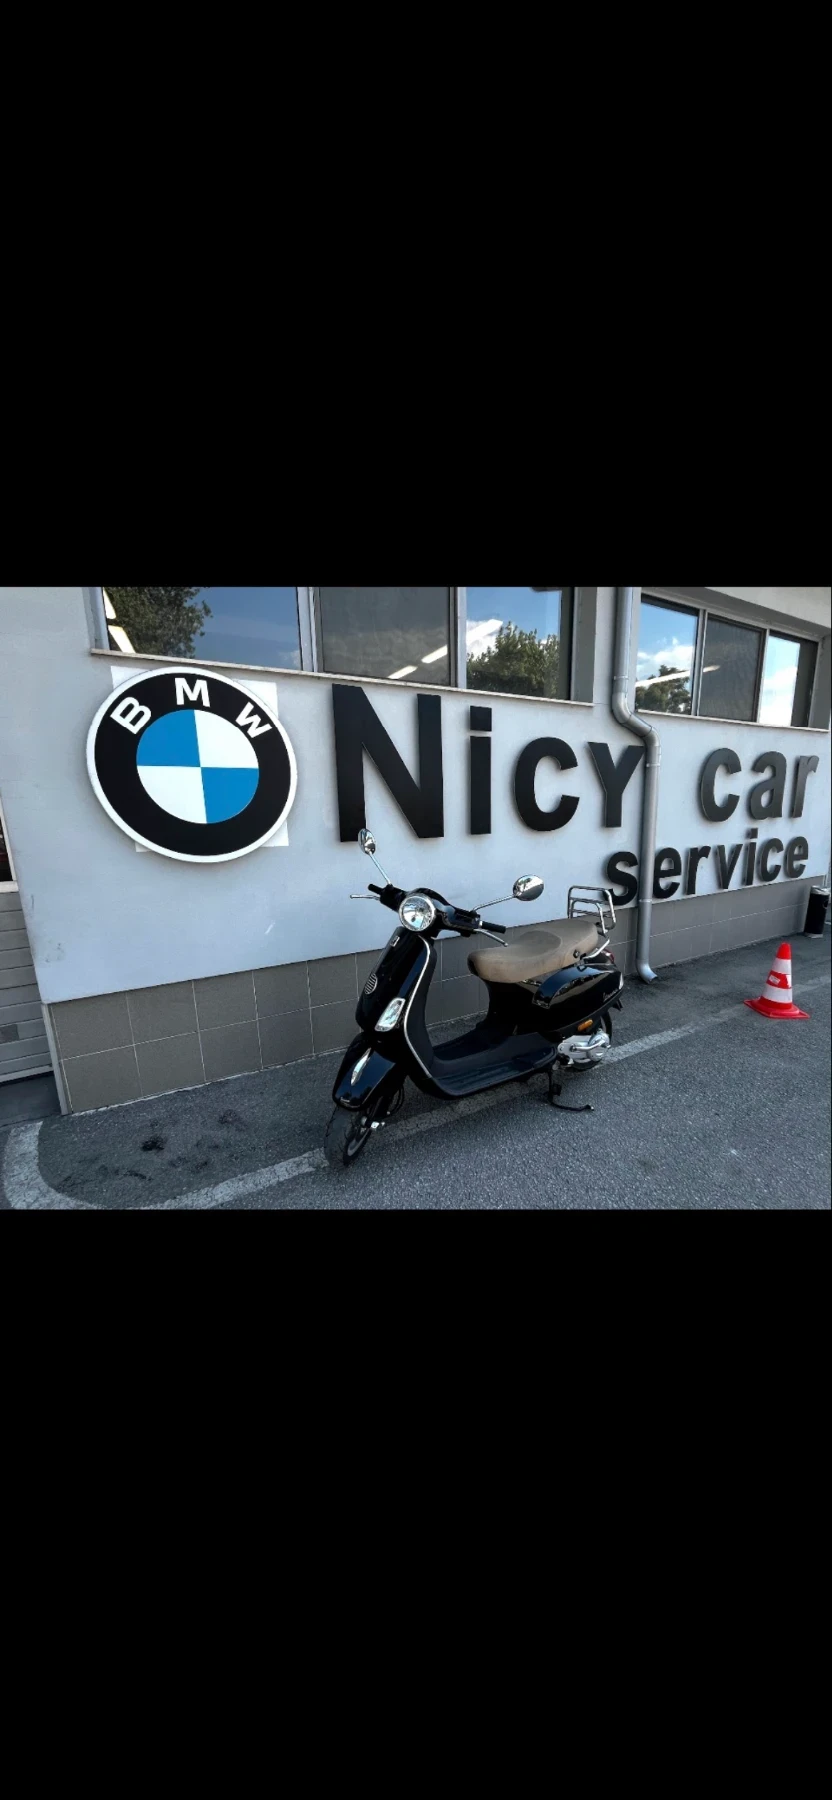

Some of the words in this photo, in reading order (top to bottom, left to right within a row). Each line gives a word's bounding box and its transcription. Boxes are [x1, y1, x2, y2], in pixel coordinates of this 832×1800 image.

[110, 677, 272, 738] BMW
[701, 748, 820, 822] car
[606, 828, 809, 905] service
